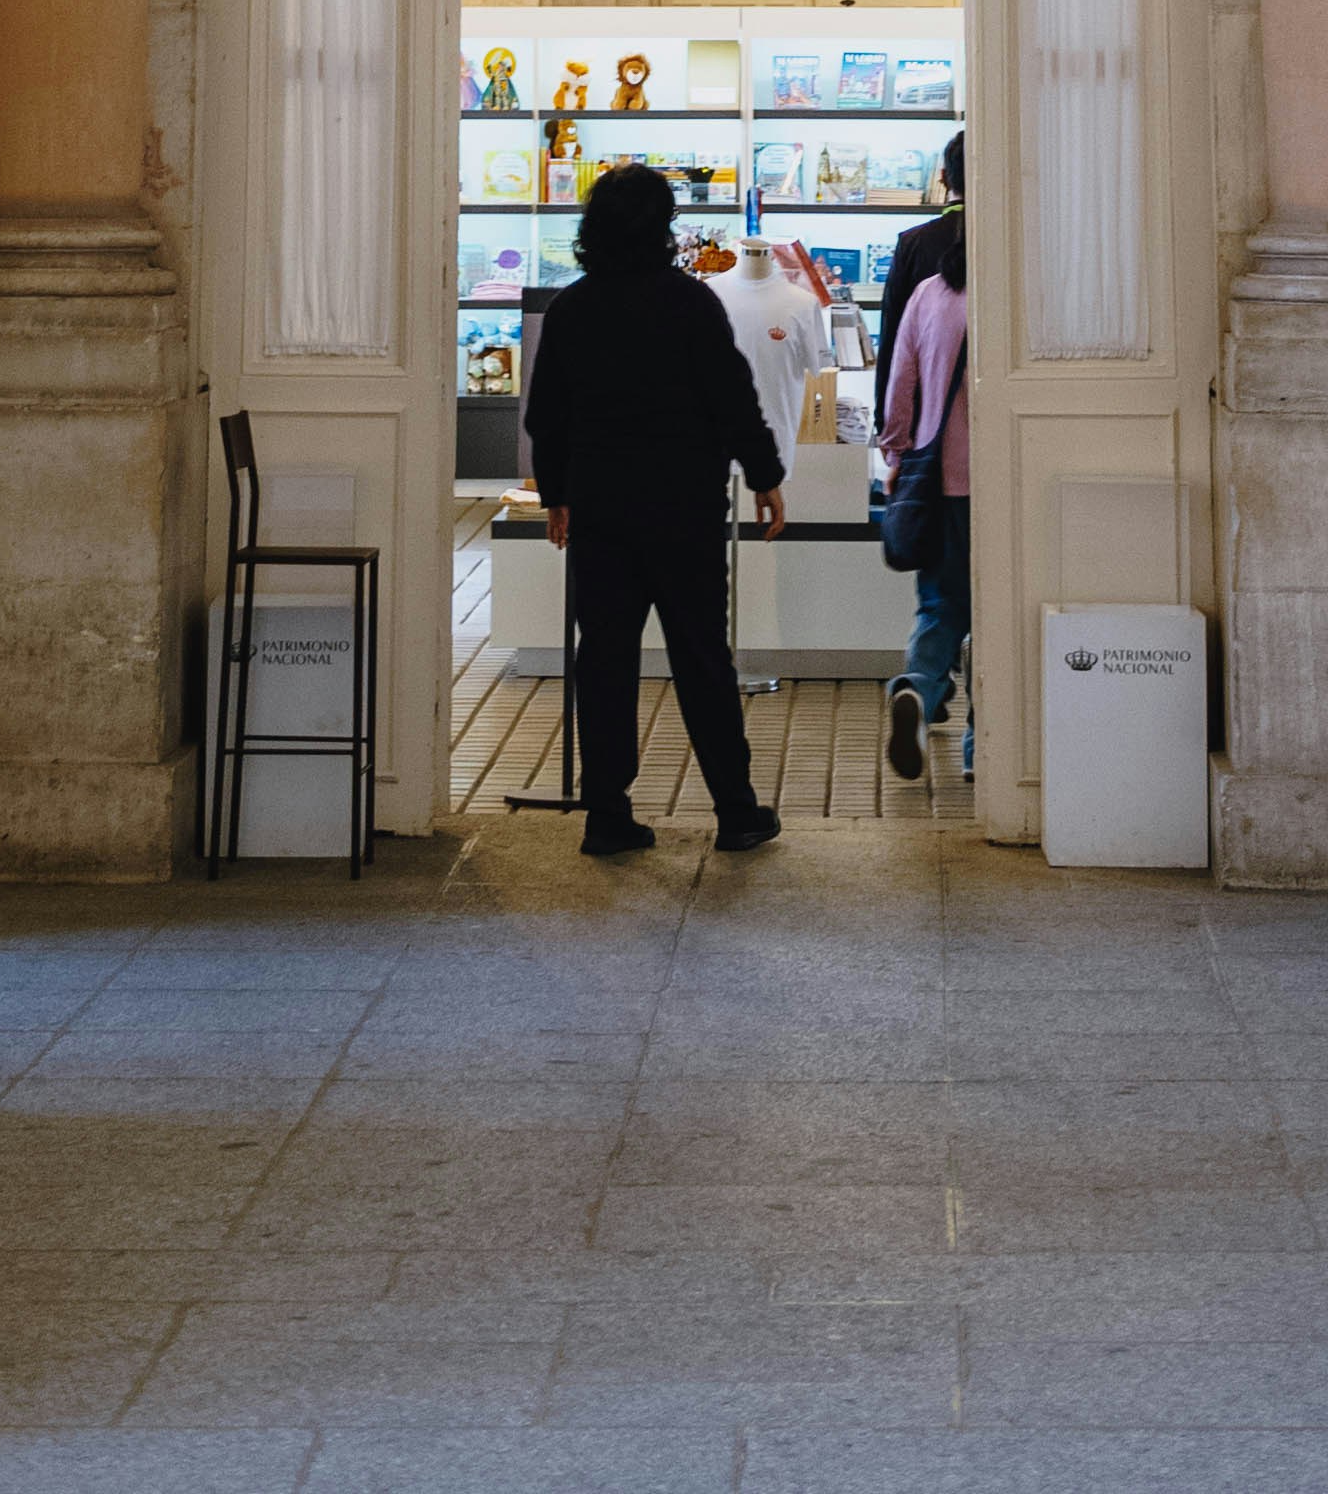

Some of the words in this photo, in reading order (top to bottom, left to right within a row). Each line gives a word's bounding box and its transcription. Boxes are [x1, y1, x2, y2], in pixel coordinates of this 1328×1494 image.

[262, 640, 350, 652] PATRIMONIO
[262, 653, 333, 665] NACIONAL
[1103, 649, 1192, 662] PATRIMONIO
[1103, 662, 1175, 675] NACIONAL
